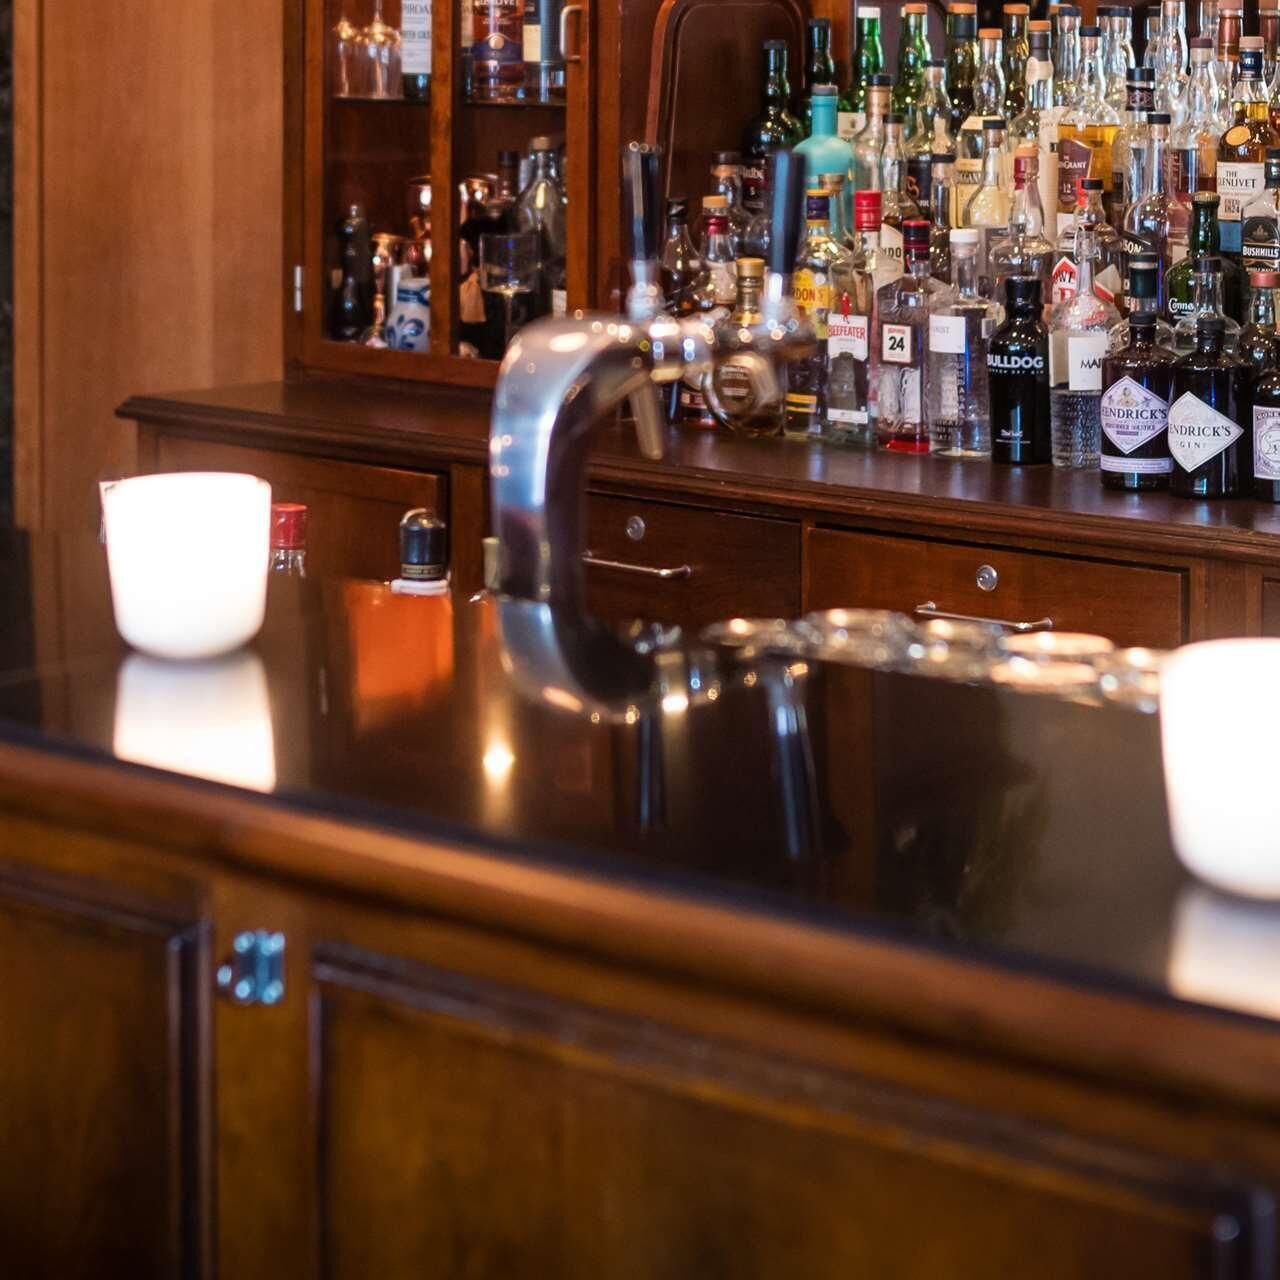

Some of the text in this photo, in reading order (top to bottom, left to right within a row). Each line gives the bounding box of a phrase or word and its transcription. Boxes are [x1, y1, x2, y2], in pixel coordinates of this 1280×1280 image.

[1242, 245, 1279, 258] BUSHMILLS
[827, 324, 866, 340] BEEFEATER
[888, 336, 905, 352] 24
[987, 353, 1044, 369] BULLDOG
[1169, 423, 1231, 437] ENDRICK'S
